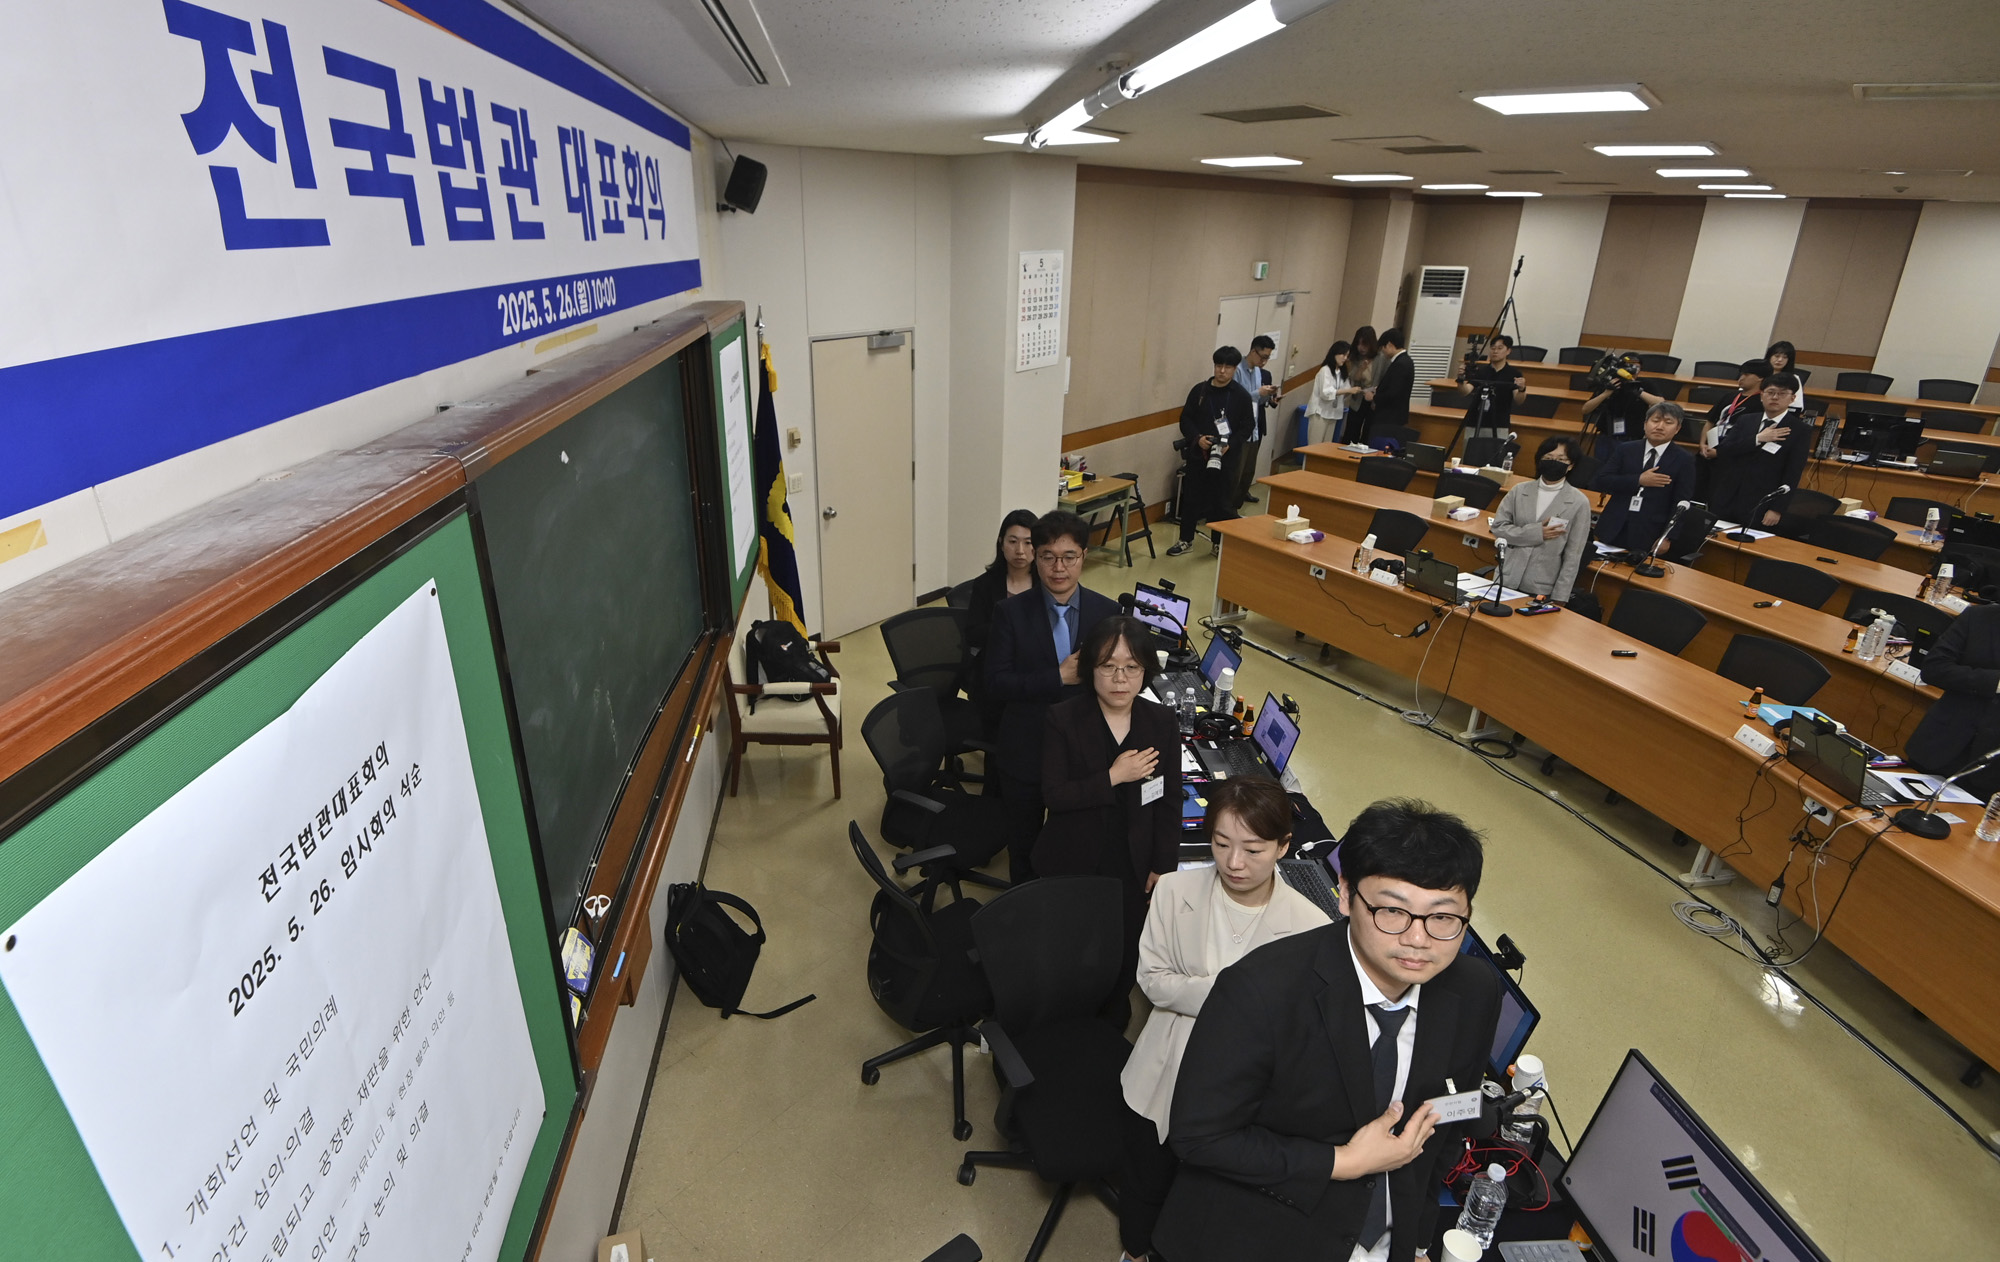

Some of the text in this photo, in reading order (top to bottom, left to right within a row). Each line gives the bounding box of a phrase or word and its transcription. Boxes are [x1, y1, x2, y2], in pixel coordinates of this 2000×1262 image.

[163, 0, 666, 251] 전국법관 대표회의
[498, 276, 616, 336] 2025. 5. 26.(월) 10:00
[228, 762, 422, 1017] 2025. 5. 26. 임시회의 식순
[258, 741, 390, 903] 전국법관대표회의
[161, 995, 339, 1259] 1. 개회선언 및 국민의례
[312, 1214, 338, 1262] 의안
[350, 1124, 386, 1192] 커뮤니티
[386, 1102, 396, 1122] 및
[398, 1069, 413, 1100] 현장
[431, 1007, 446, 1036] 의안
[319, 1109, 355, 1177] 공정한
[357, 1047, 389, 1105] 재판을
[393, 1005, 411, 1043] 위한
[413, 968, 432, 1006] 안건
[373, 1171, 396, 1218] 논의
[396, 1142, 408, 1169] 및
[409, 1100, 430, 1142] 의결
